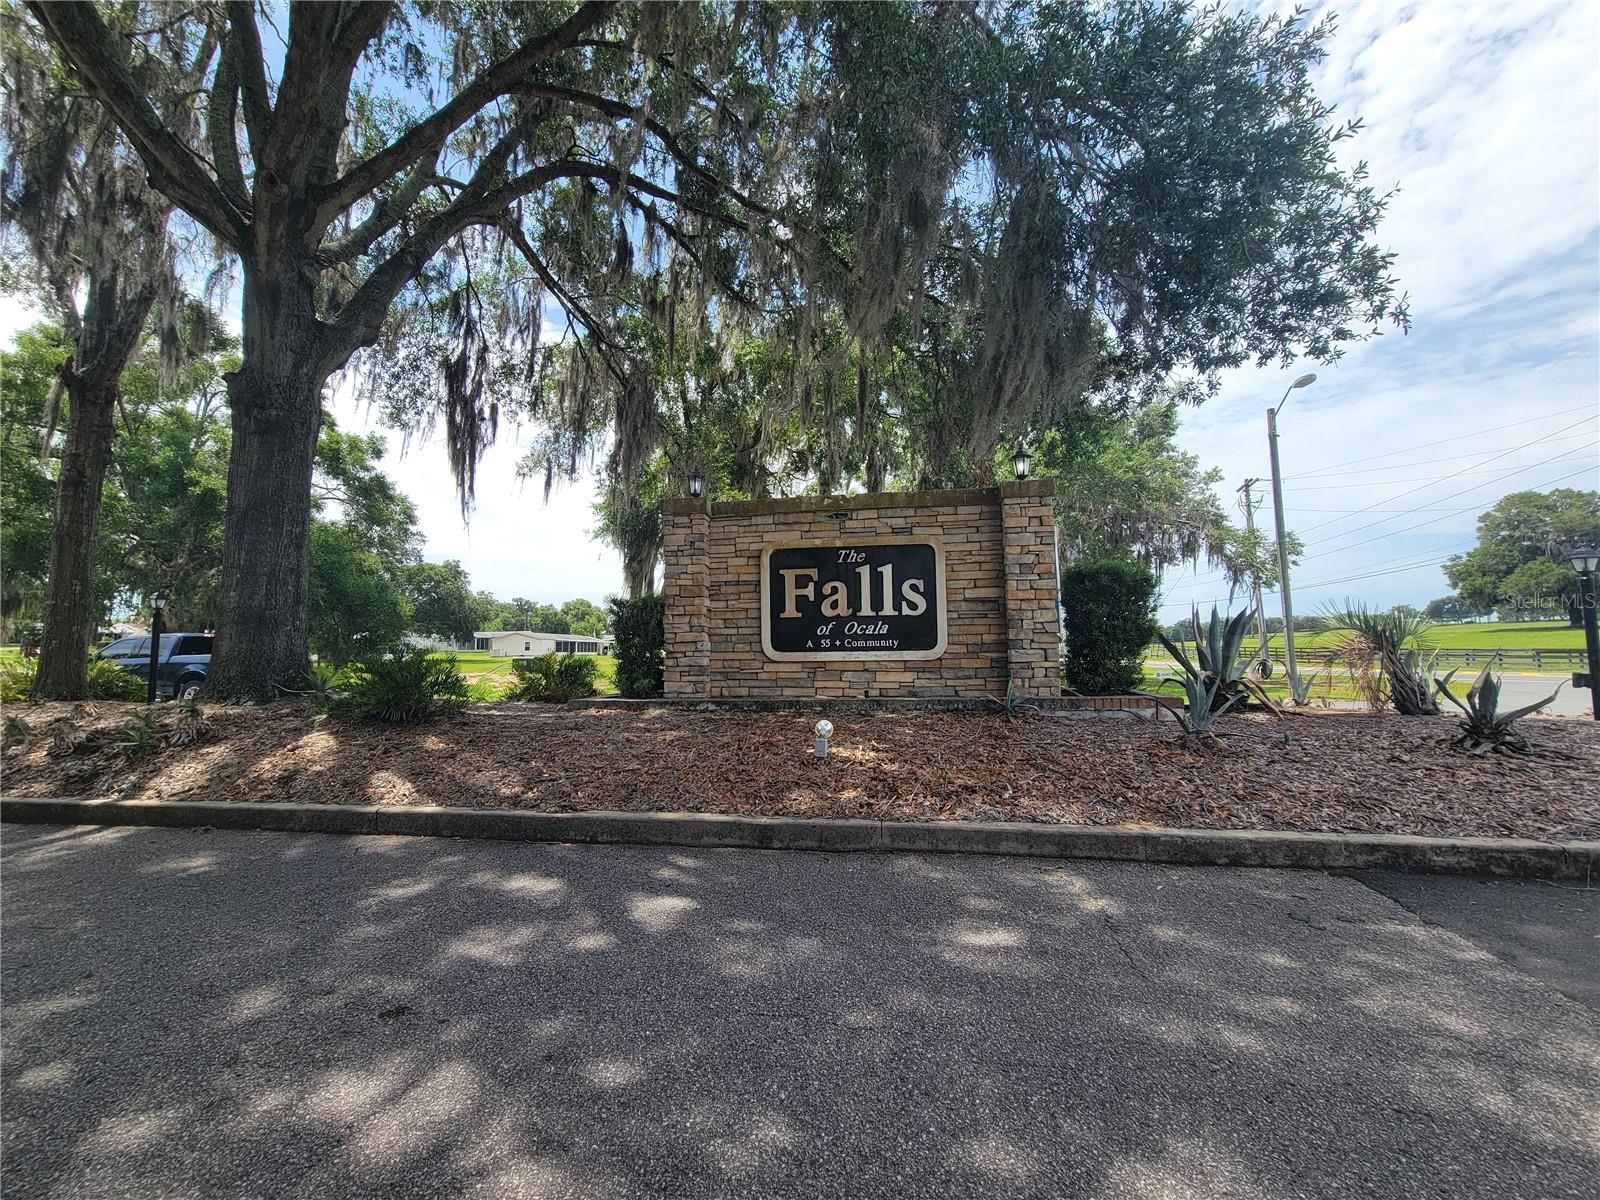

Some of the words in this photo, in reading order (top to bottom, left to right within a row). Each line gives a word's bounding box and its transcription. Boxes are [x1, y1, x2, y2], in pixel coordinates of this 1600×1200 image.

[836, 549, 866, 563] The
[779, 563, 927, 618] Falls
[816, 621, 836, 636] of
[844, 621, 889, 635] Ocala
[806, 640, 813, 648] A
[820, 639, 831, 647] 55
[844, 638, 899, 649] Community
